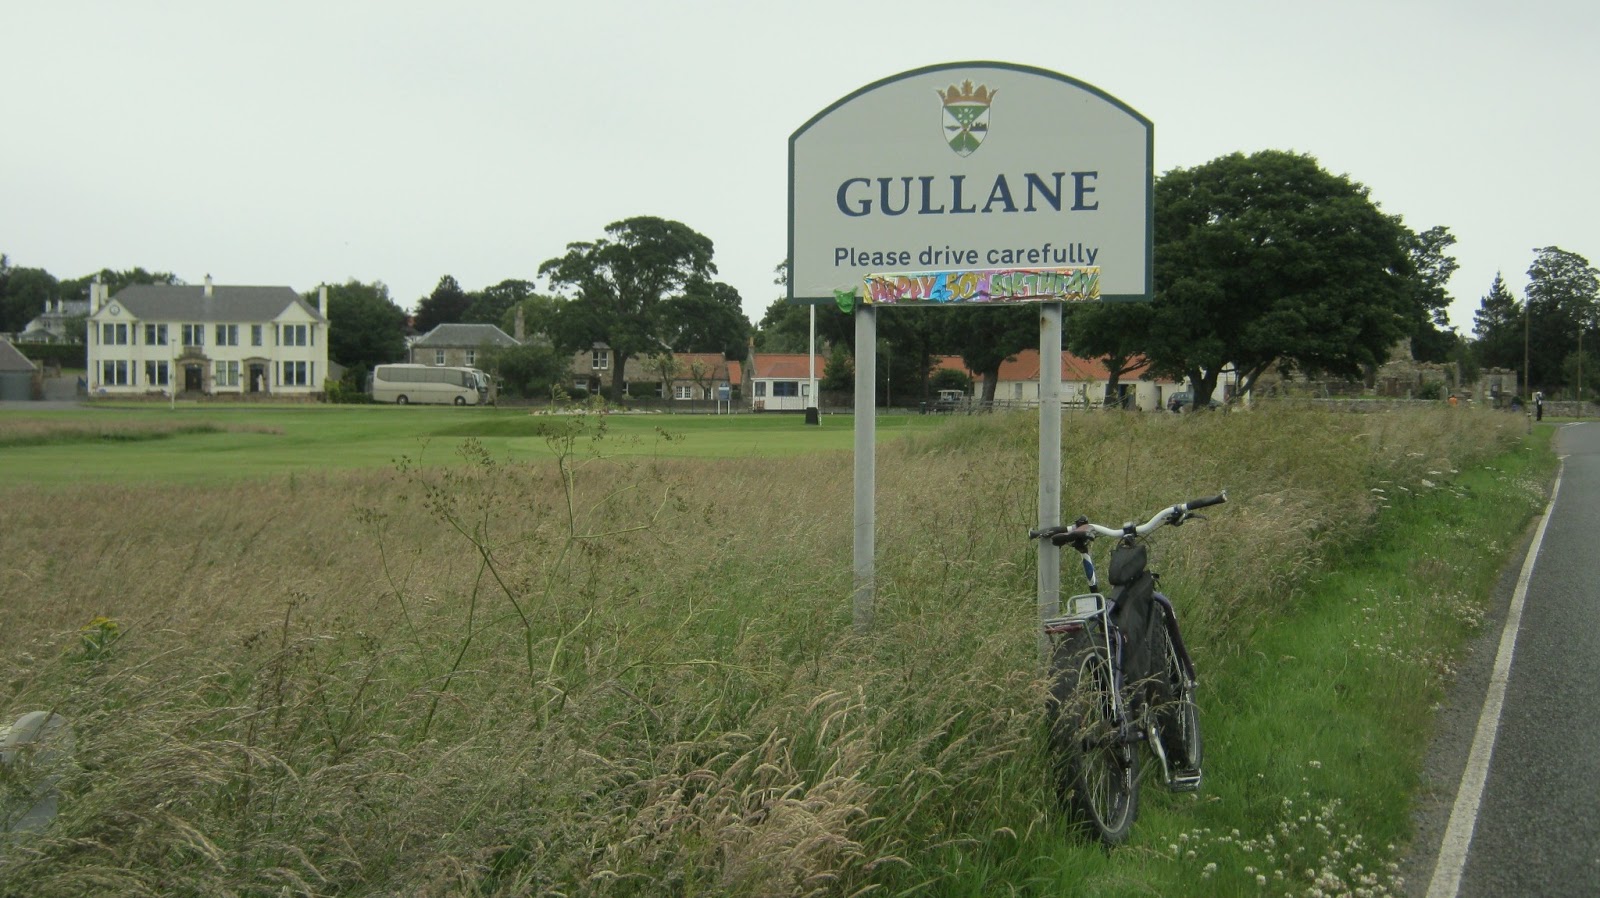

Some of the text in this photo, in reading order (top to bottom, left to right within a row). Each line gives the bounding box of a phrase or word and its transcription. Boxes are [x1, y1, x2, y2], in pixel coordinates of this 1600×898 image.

[836, 171, 1099, 217] GULLANE
[835, 242, 1098, 266] Please drive carefully
[870, 275, 936, 301] HAPPY
[989, 269, 1098, 297] BIRTHDAY
